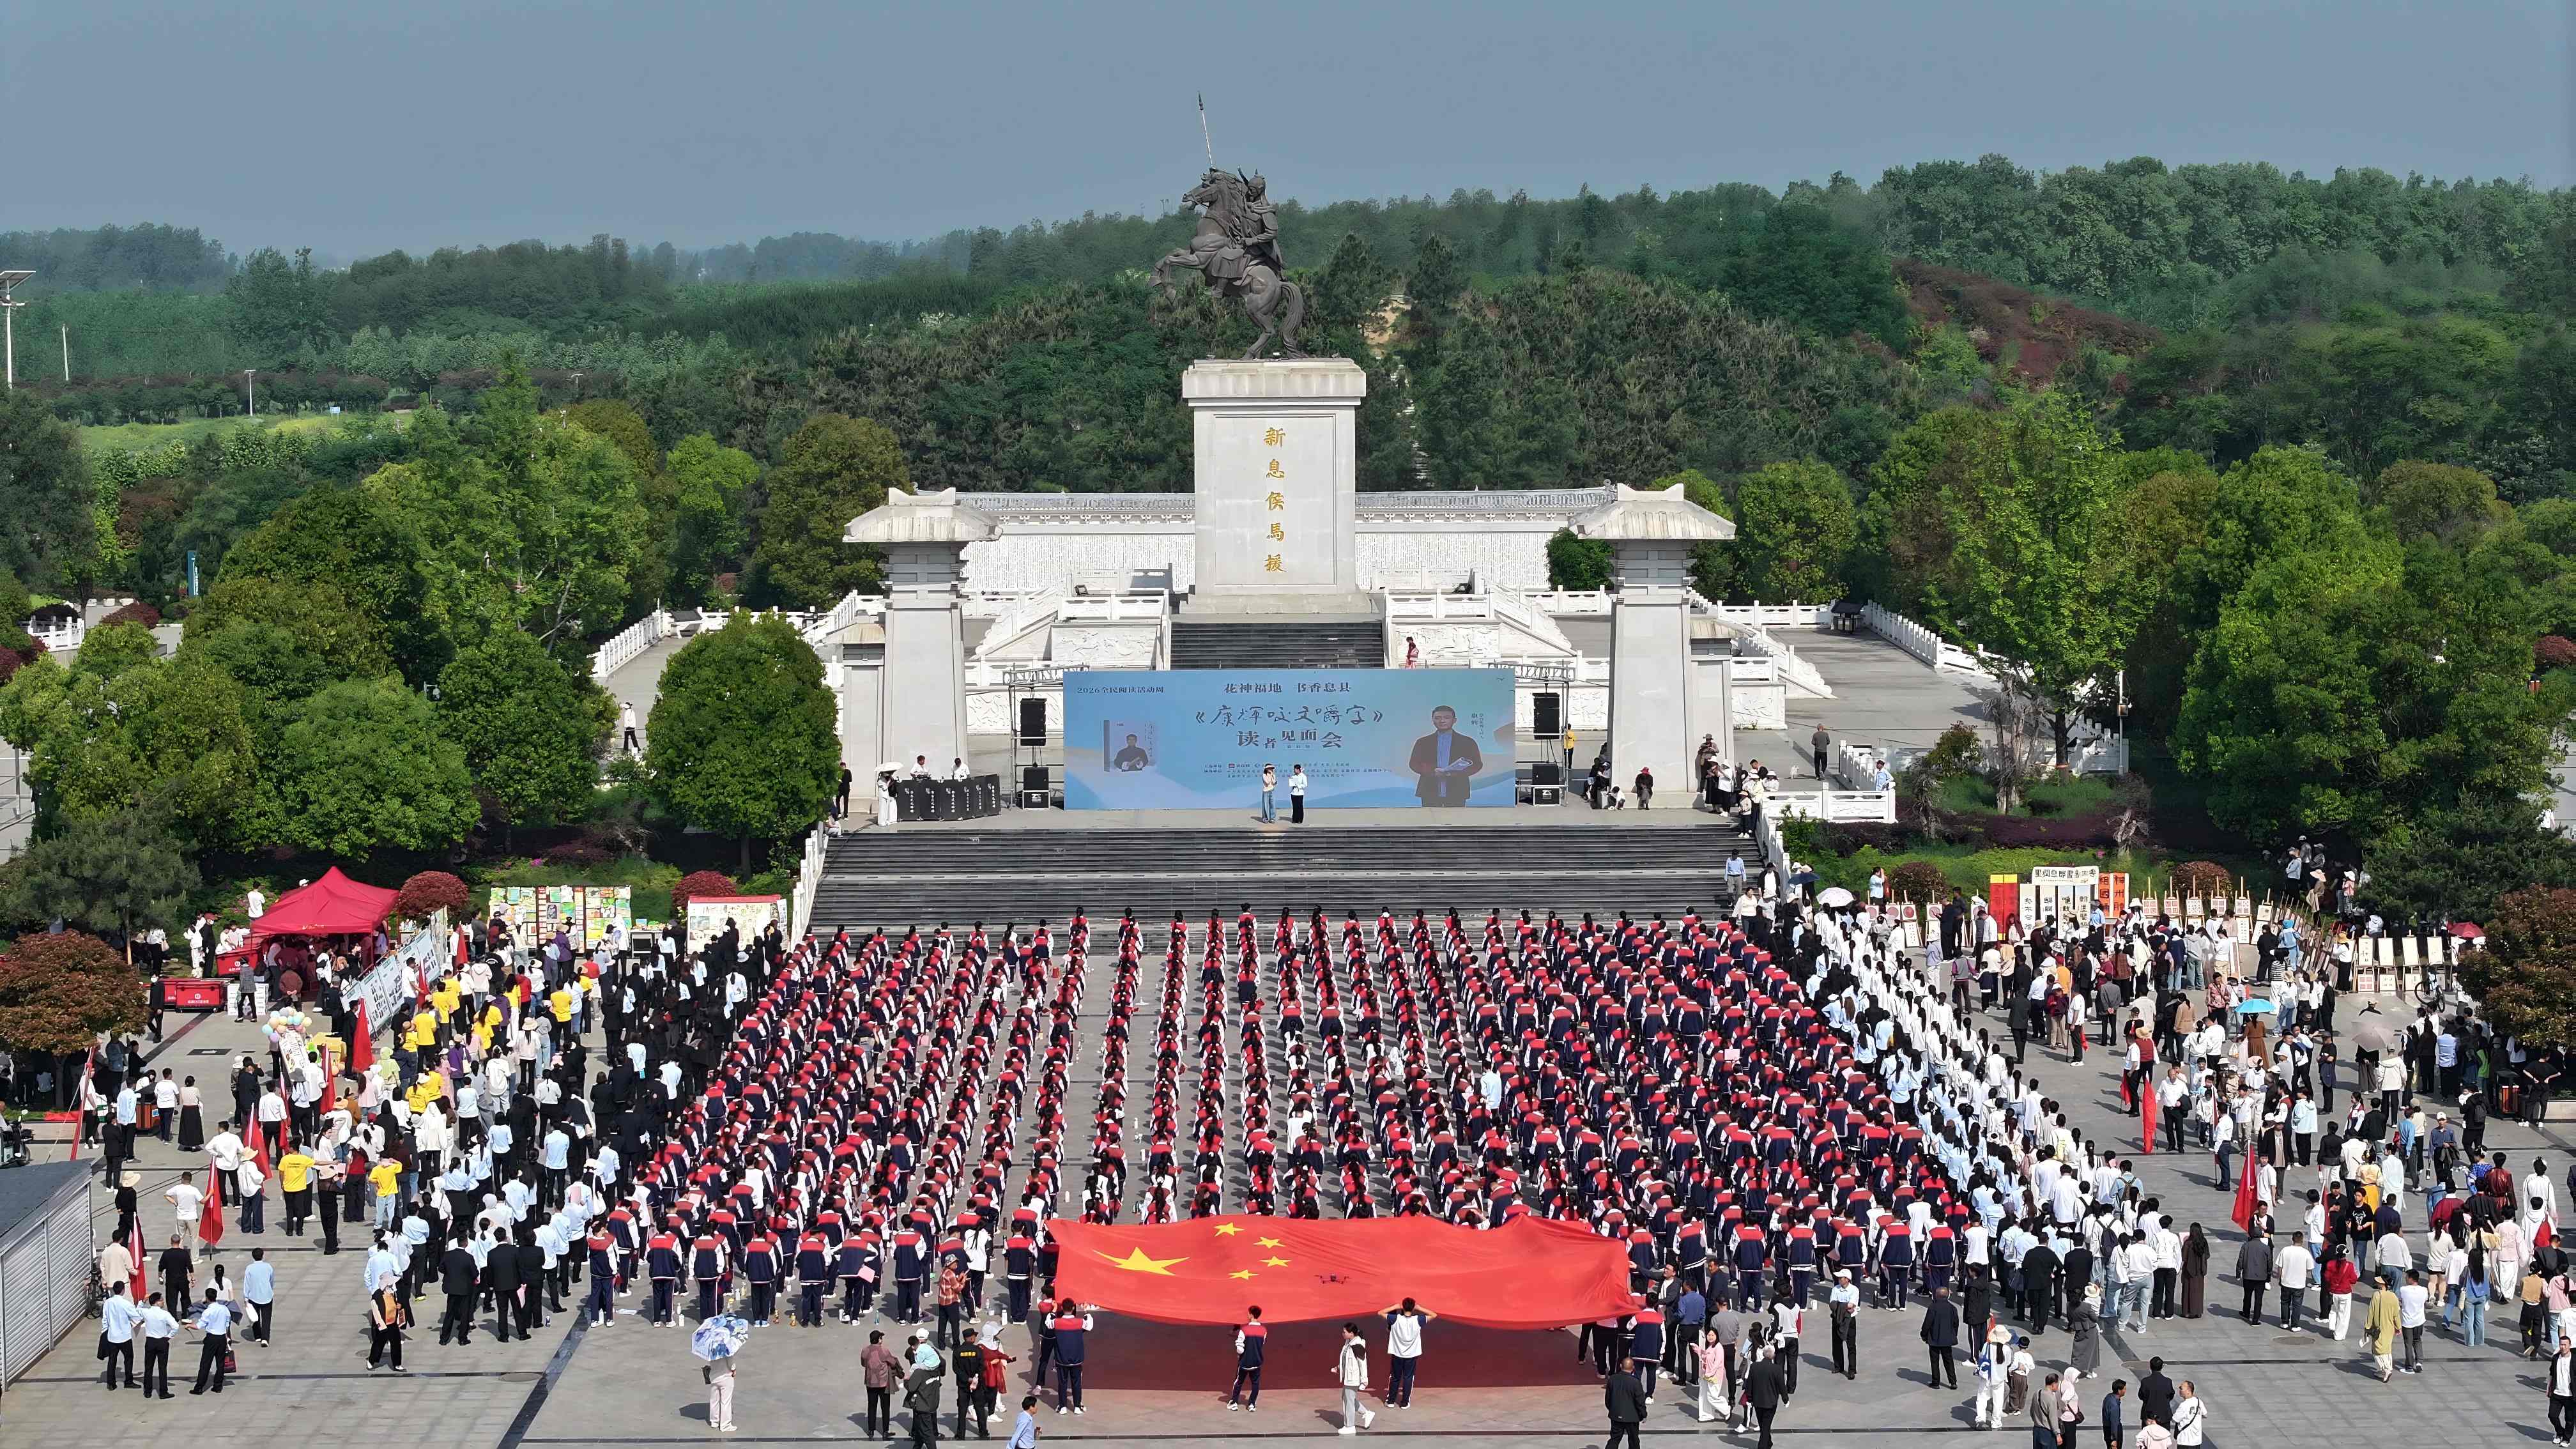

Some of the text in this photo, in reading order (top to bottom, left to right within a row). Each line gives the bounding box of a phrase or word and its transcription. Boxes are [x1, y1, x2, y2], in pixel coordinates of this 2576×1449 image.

[1224, 682, 1351, 693] 花神福地 书香息县
[1237, 728, 1342, 749] 读者见面会
